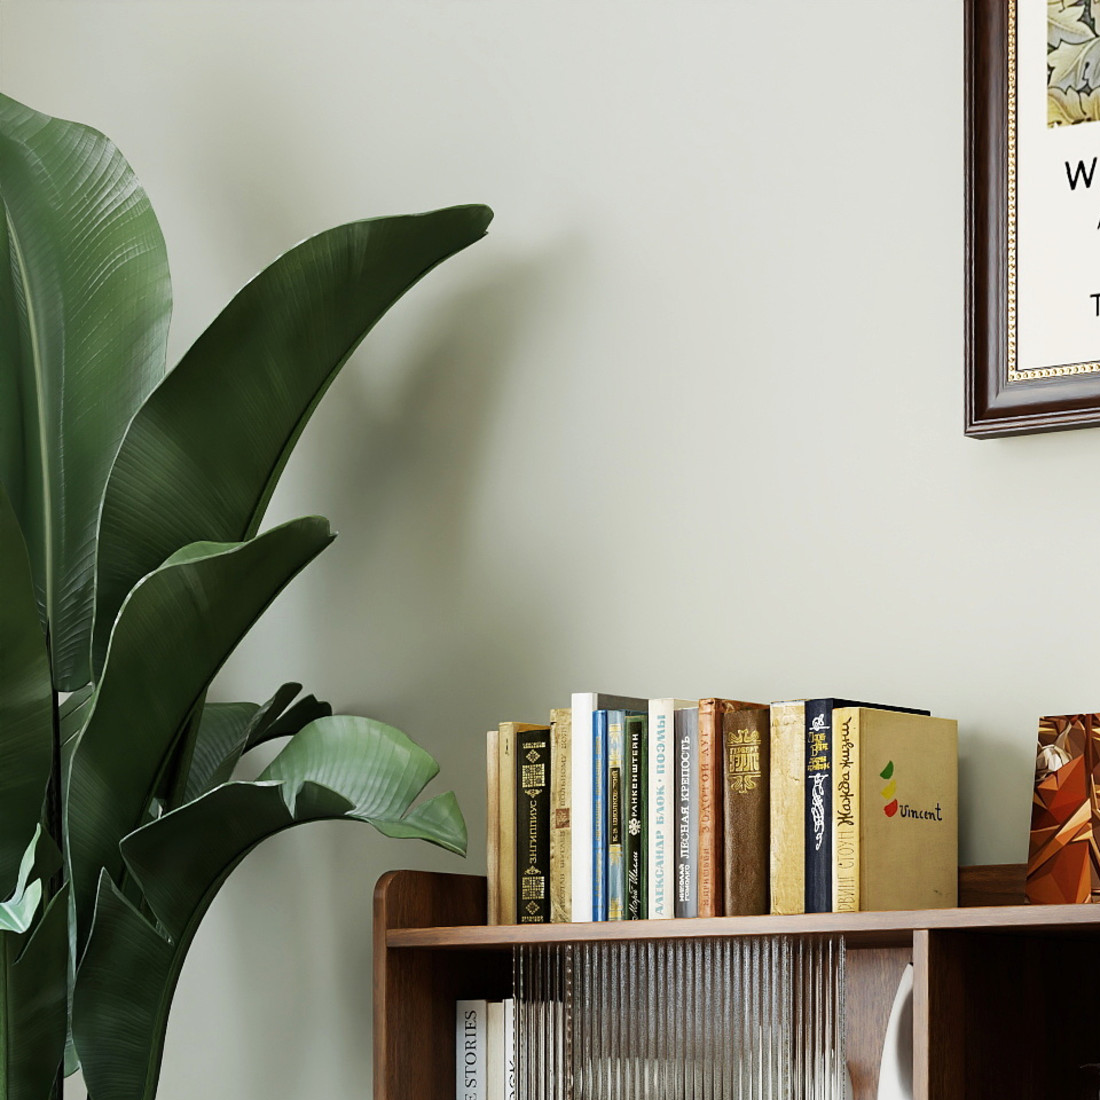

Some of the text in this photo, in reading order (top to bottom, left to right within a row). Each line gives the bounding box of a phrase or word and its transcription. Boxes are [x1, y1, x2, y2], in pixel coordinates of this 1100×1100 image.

[628, 733, 641, 836] ФРАНКЕНШТЕЙН
[700, 731, 709, 756] ЛУГ
[655, 715, 666, 916] АЛЕКСАНДР БЛОК ПОЭМЫ
[680, 735, 691, 859] ЛЕСНАЯ КРЕПОСТЬ
[700, 763, 709, 833] ЗОЛОТОЙ
[836, 716, 855, 913] РВИНГ СТОУН Жажда жизни
[899, 802, 943, 821] Vincent
[464, 1009, 478, 1088] STORIES
